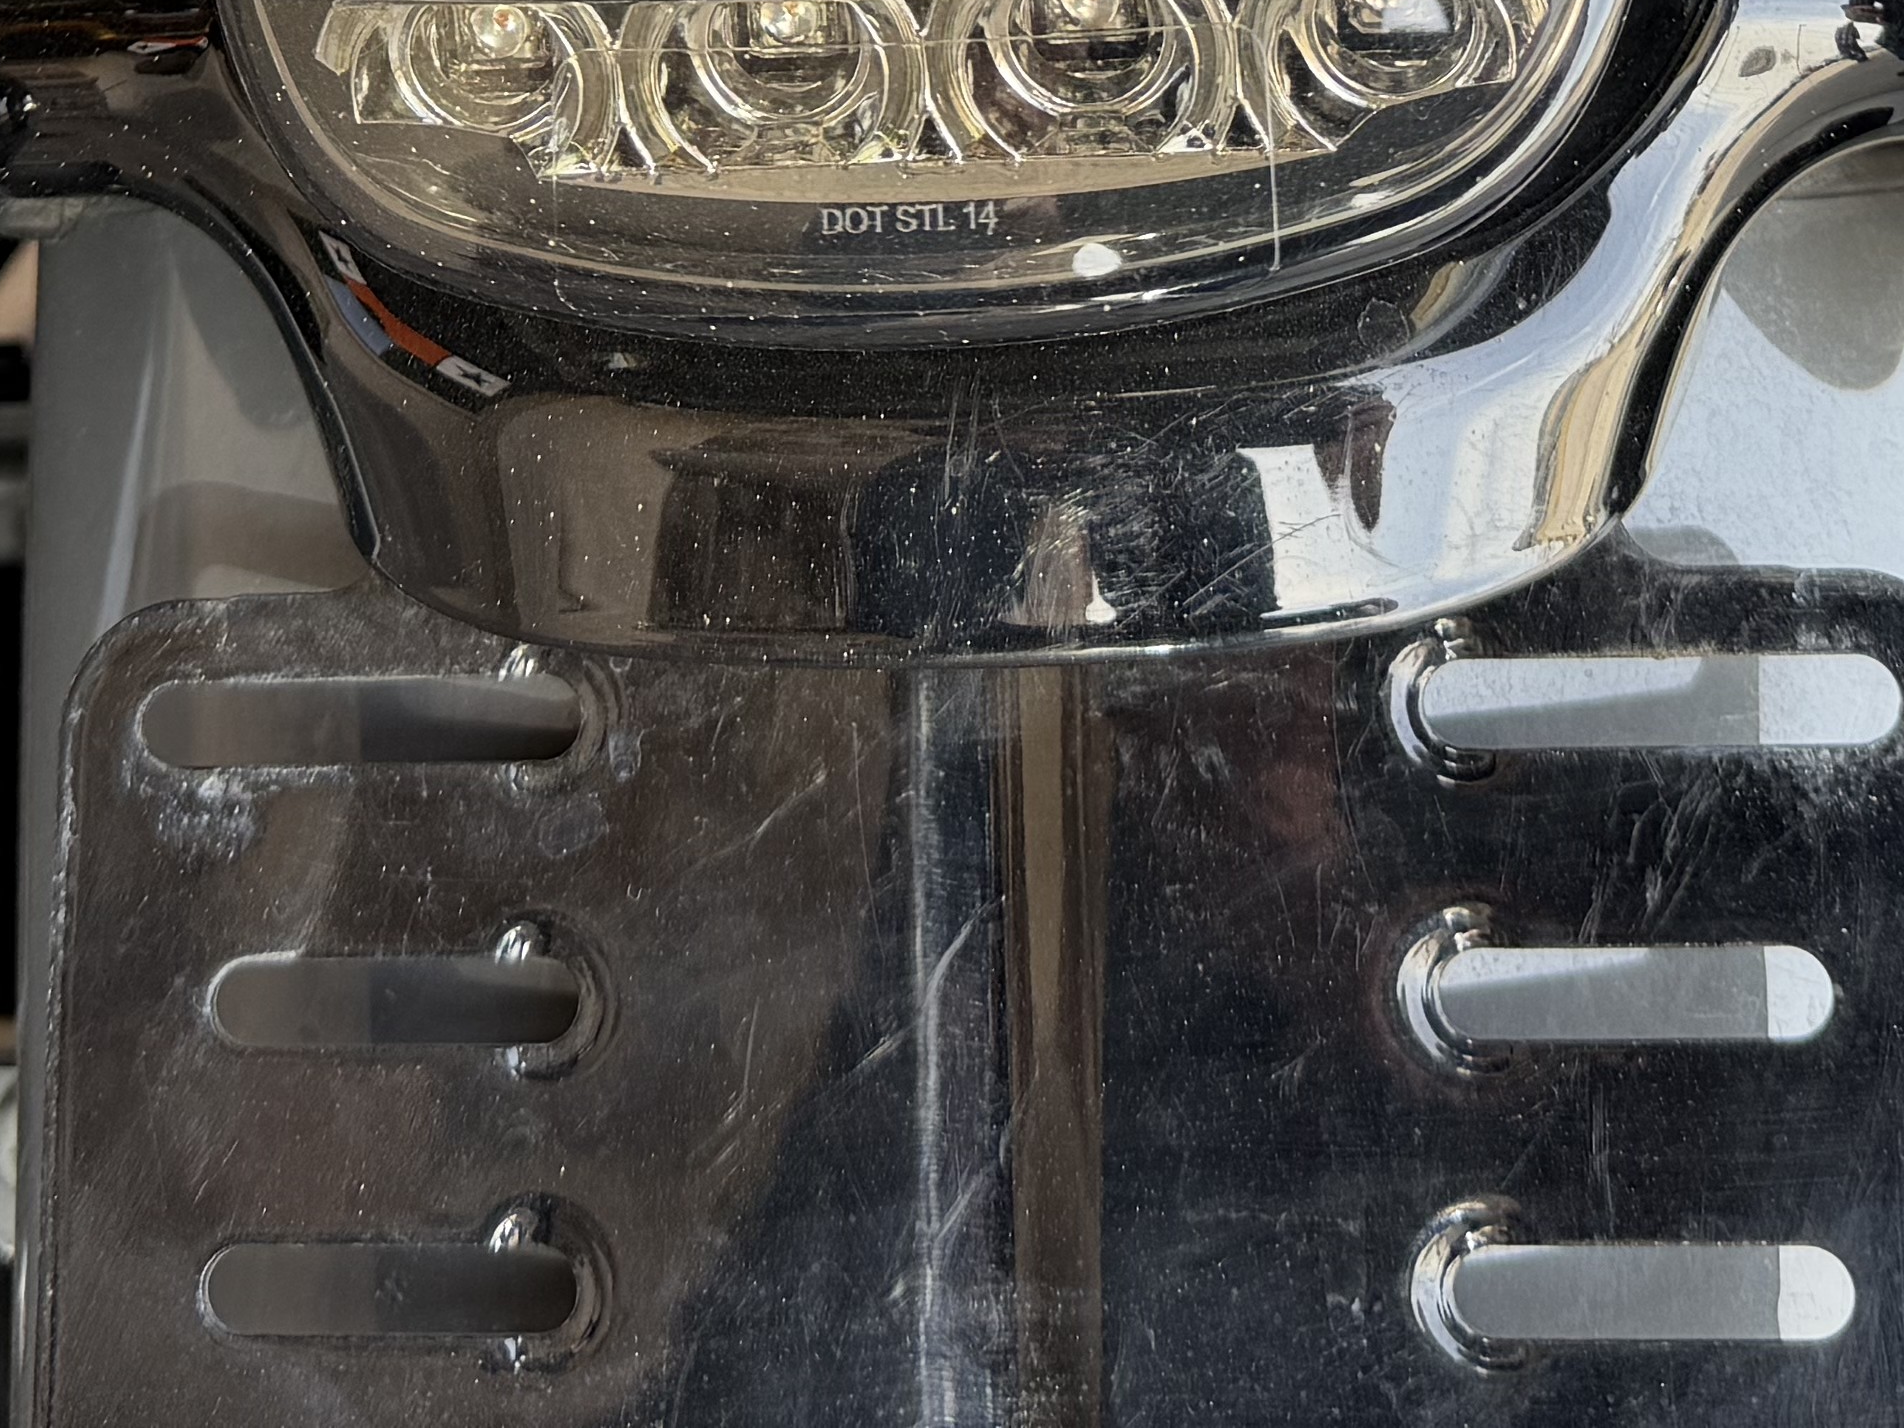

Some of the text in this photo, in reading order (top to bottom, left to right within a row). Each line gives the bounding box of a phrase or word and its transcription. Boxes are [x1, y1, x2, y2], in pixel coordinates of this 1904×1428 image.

[821, 200, 998, 236] DOT STL 14
